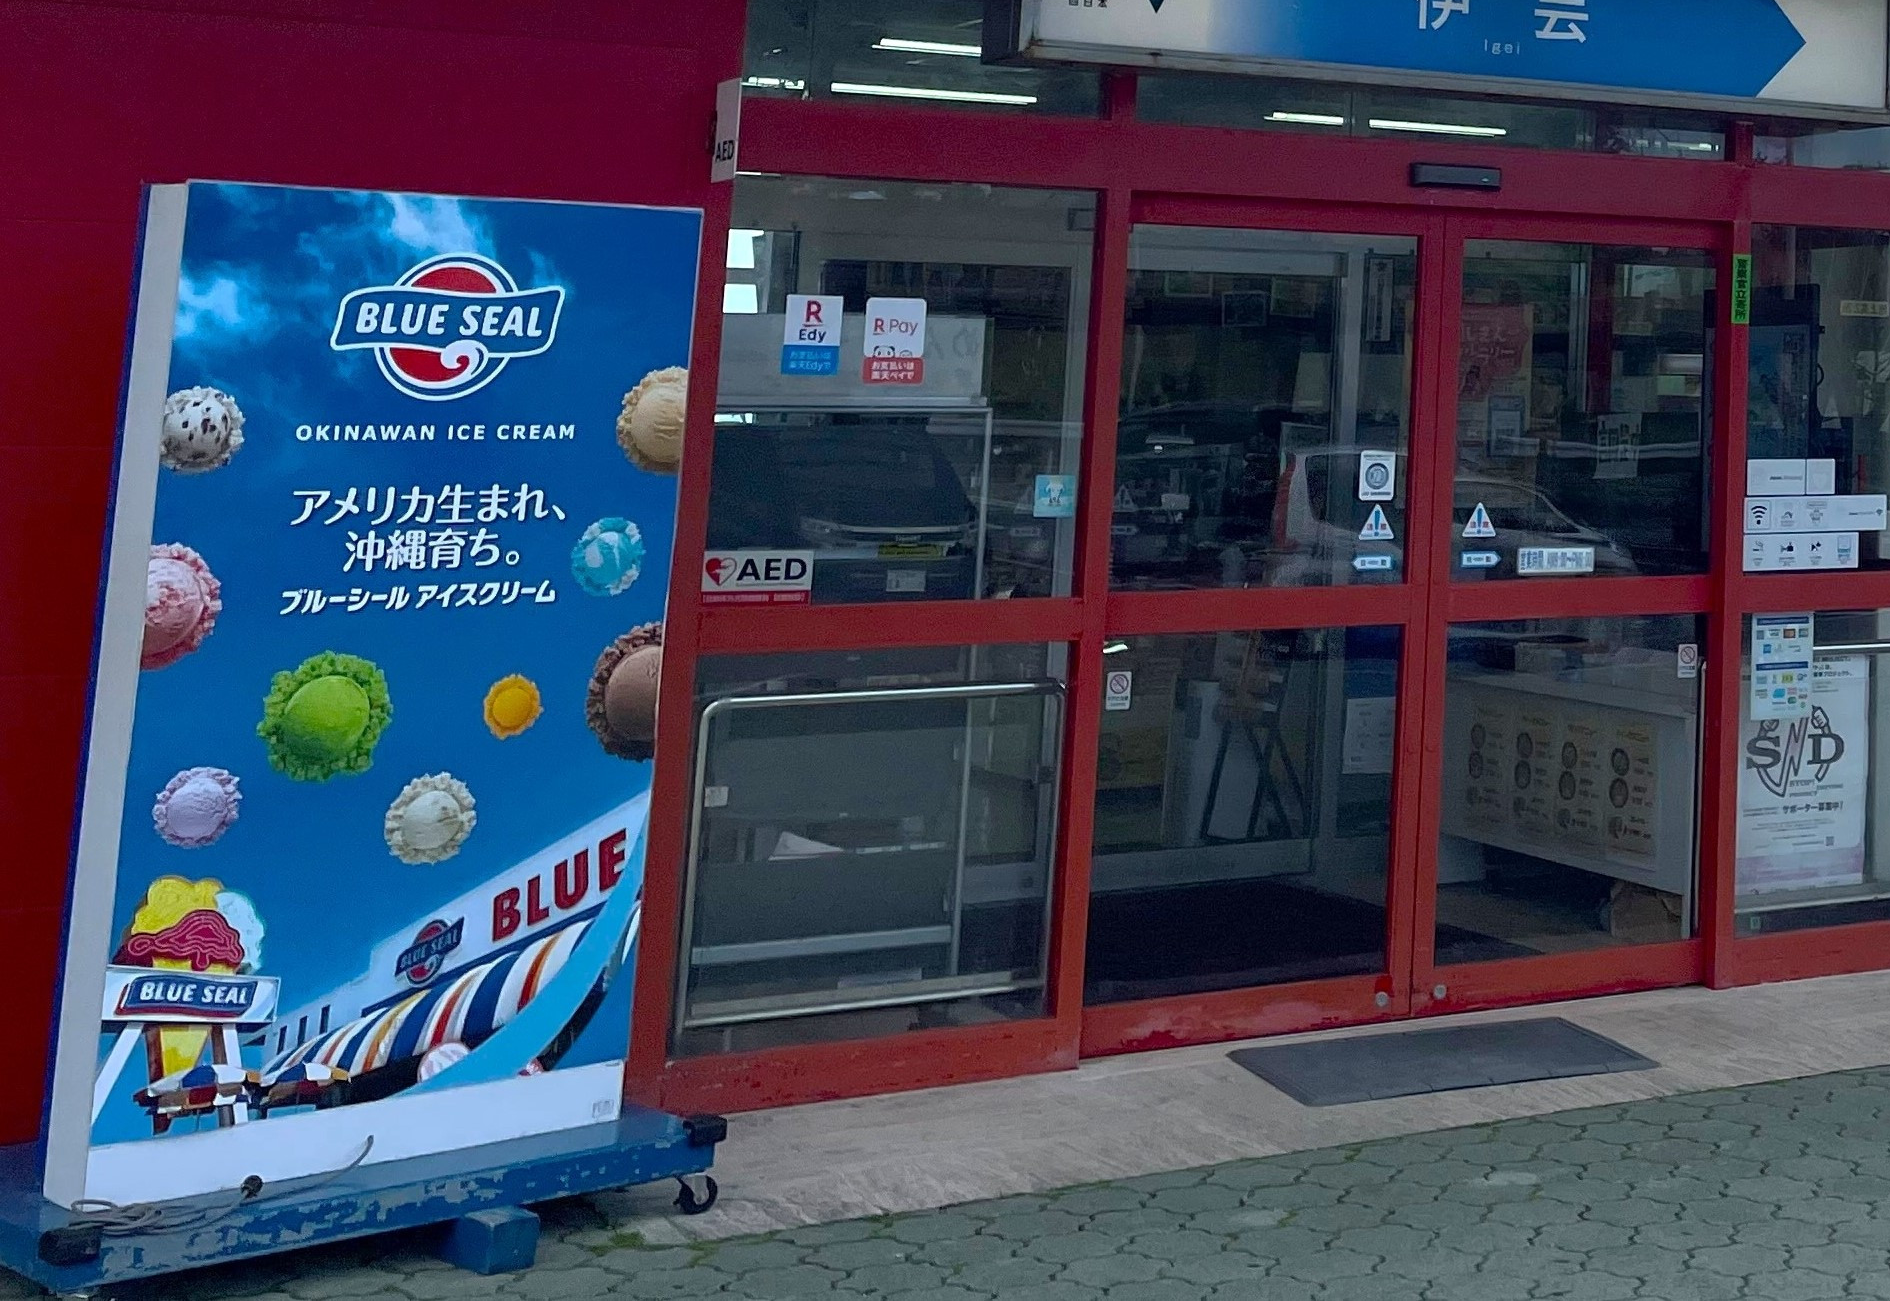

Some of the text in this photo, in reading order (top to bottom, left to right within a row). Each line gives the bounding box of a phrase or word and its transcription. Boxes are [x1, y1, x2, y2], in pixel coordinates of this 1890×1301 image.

[715, 140, 735, 162] AED
[355, 301, 543, 338] BLUE SEAL
[805, 300, 822, 323] R
[799, 329, 827, 343] Edy
[873, 318, 918, 336] R Pay
[295, 424, 576, 442] OKINAWAN ICE CREAM
[289, 482, 567, 526] アメリカ生まれ、
[342, 527, 520, 572] 沖縄育ち。
[736, 558, 807, 581] AED
[280, 580, 556, 615] ブルーシール アイスクリーム
[491, 828, 627, 942] BLUE
[139, 980, 248, 1006] BLUE SEAL
